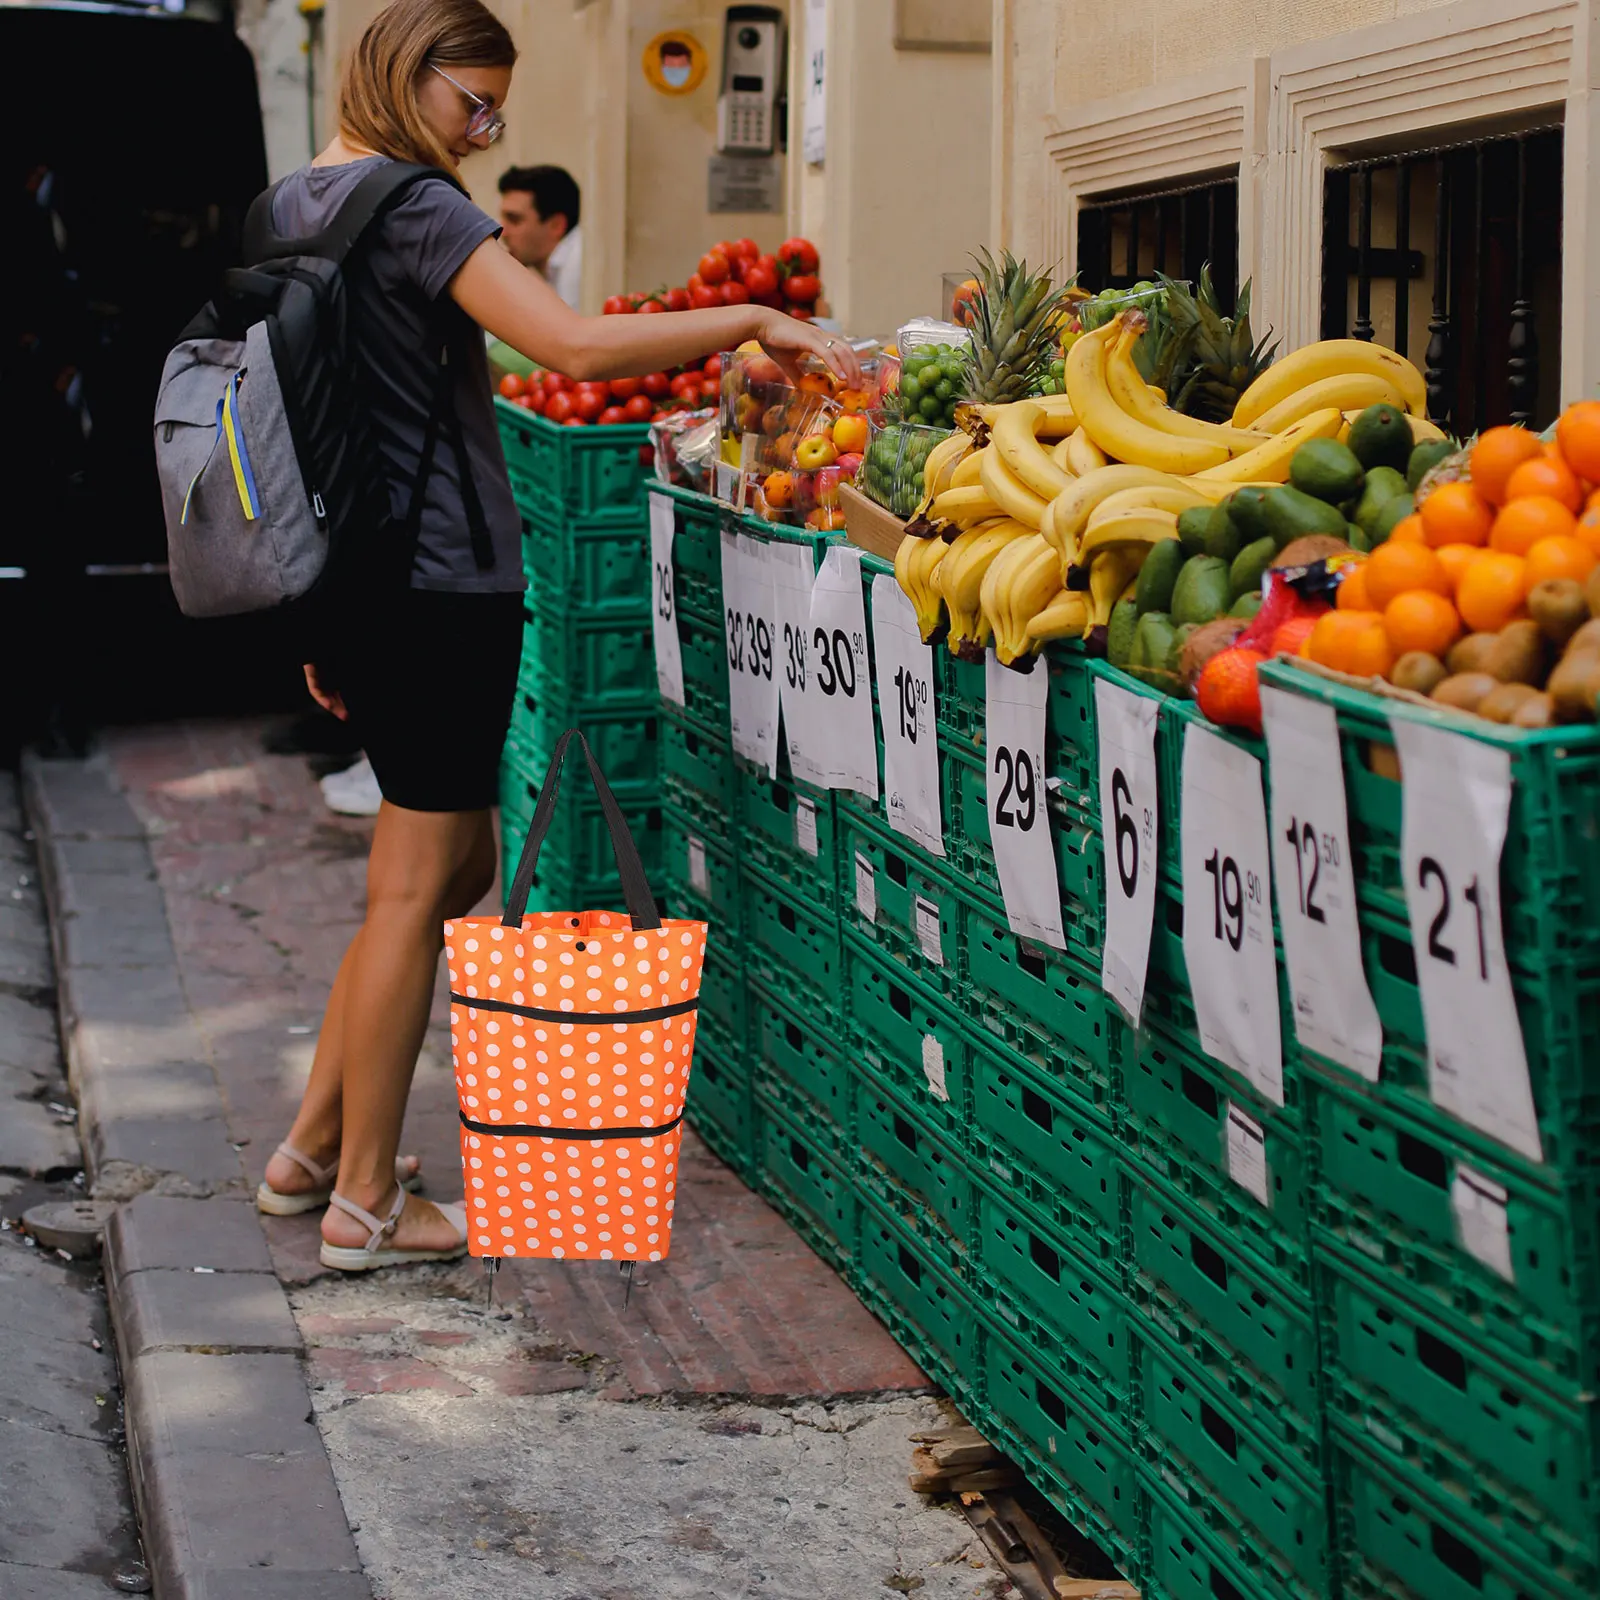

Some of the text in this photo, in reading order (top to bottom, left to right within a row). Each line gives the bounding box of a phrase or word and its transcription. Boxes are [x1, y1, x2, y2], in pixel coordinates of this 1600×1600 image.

[746, 612, 773, 682] 39
[783, 622, 806, 693] 39
[813, 626, 856, 698] 30
[994, 745, 1036, 832] 29
[1111, 767, 1139, 899] 6
[1204, 846, 1245, 953] 19
[1419, 855, 1489, 981] 21
